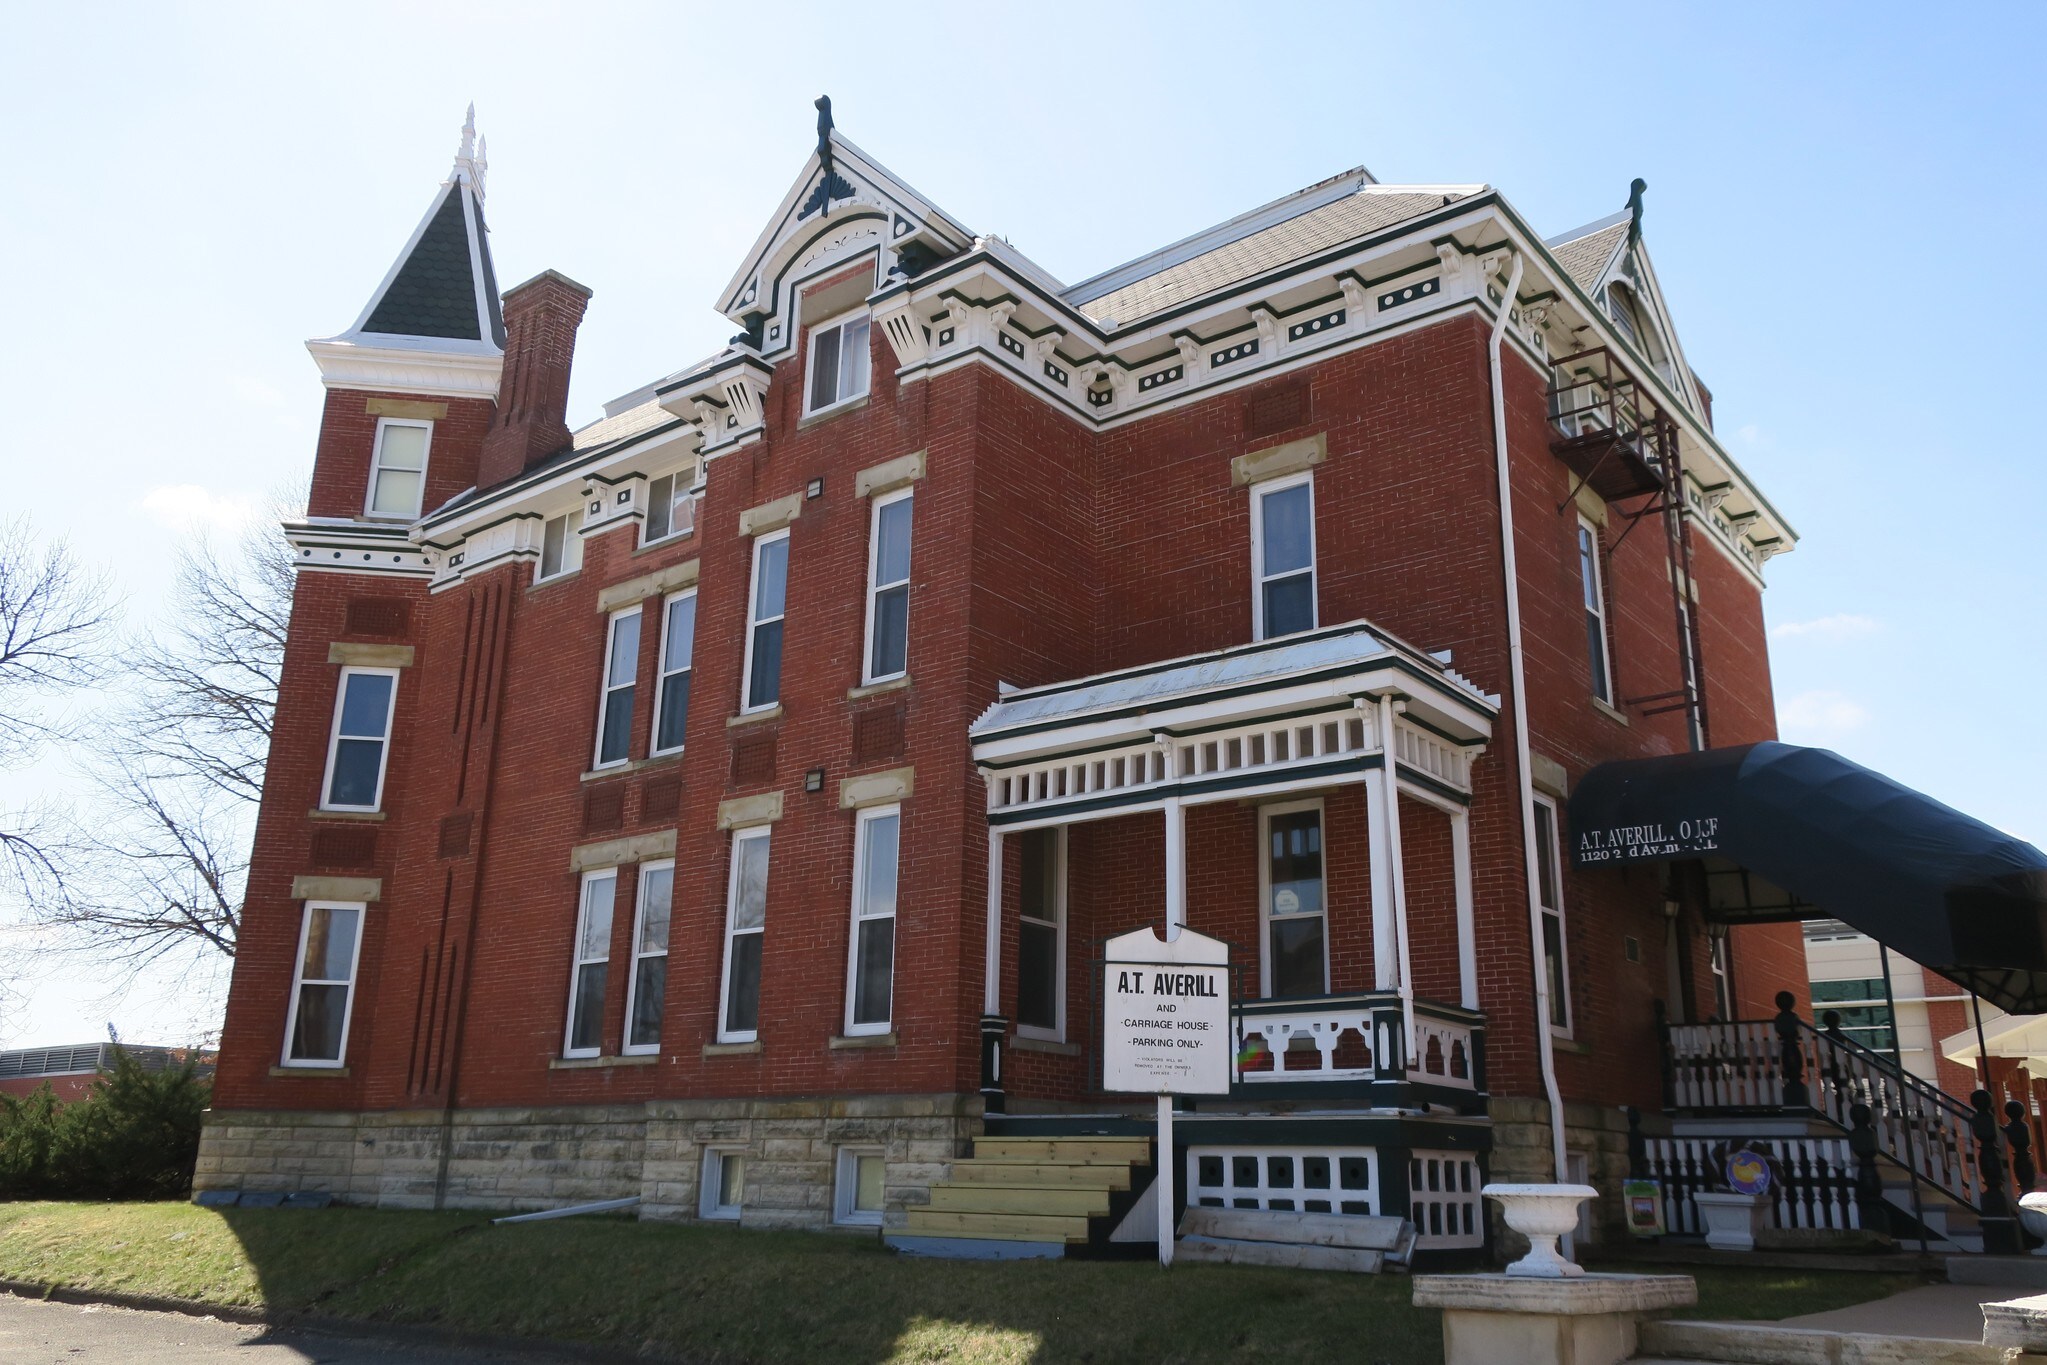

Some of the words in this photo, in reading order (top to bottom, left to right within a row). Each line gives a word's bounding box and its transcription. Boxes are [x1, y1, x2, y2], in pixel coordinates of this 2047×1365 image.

[1581, 831, 1604, 850] A.T.
[1608, 824, 1667, 847] AVERILL
[1581, 850, 1610, 862] 1120
[1118, 971, 1144, 994] A.T.
[1153, 973, 1219, 997] AVERILL
[1156, 1004, 1177, 1013] AND
